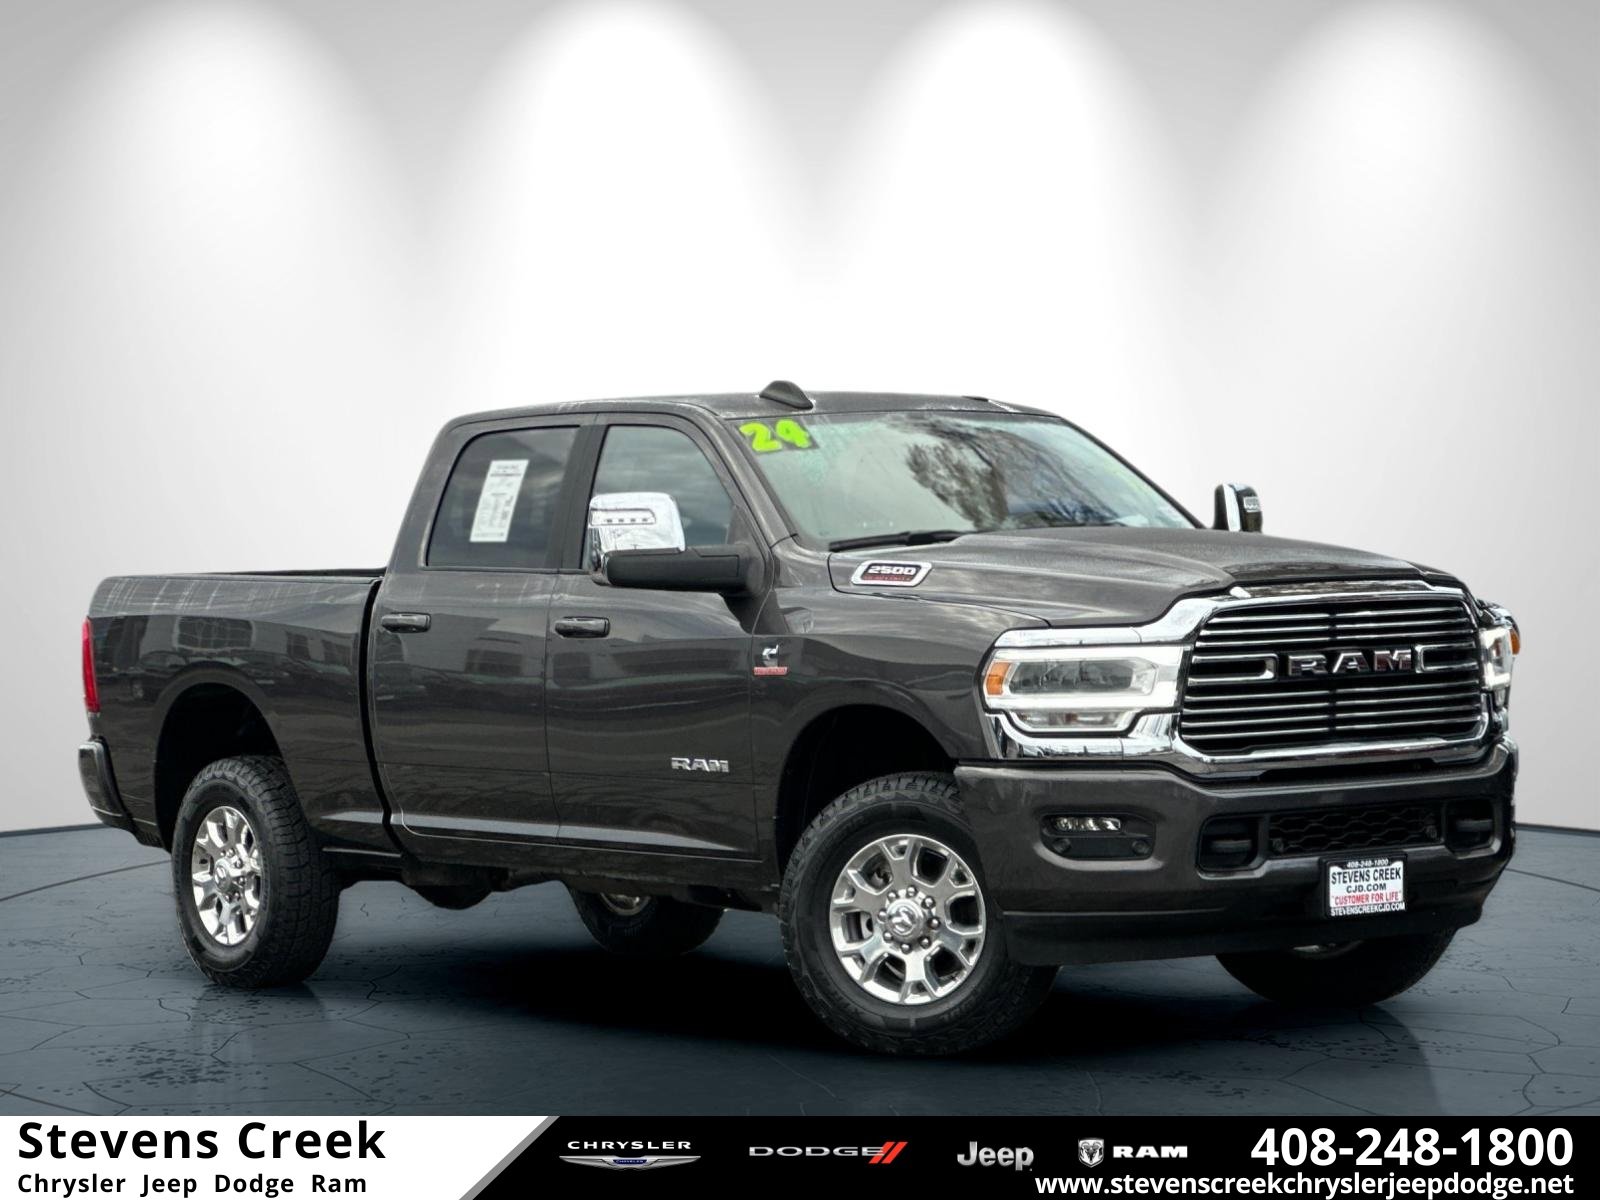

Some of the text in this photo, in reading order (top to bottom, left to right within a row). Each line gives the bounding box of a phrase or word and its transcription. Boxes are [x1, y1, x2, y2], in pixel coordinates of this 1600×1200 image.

[739, 418, 811, 452] 24
[867, 565, 917, 576] 2500
[1288, 649, 1412, 677] RAM
[671, 757, 729, 772] RAM
[1331, 867, 1402, 885] STEVENS CREEK
[1346, 883, 1387, 893] CJD.COM
[1371, 892, 1384, 903] FOR
